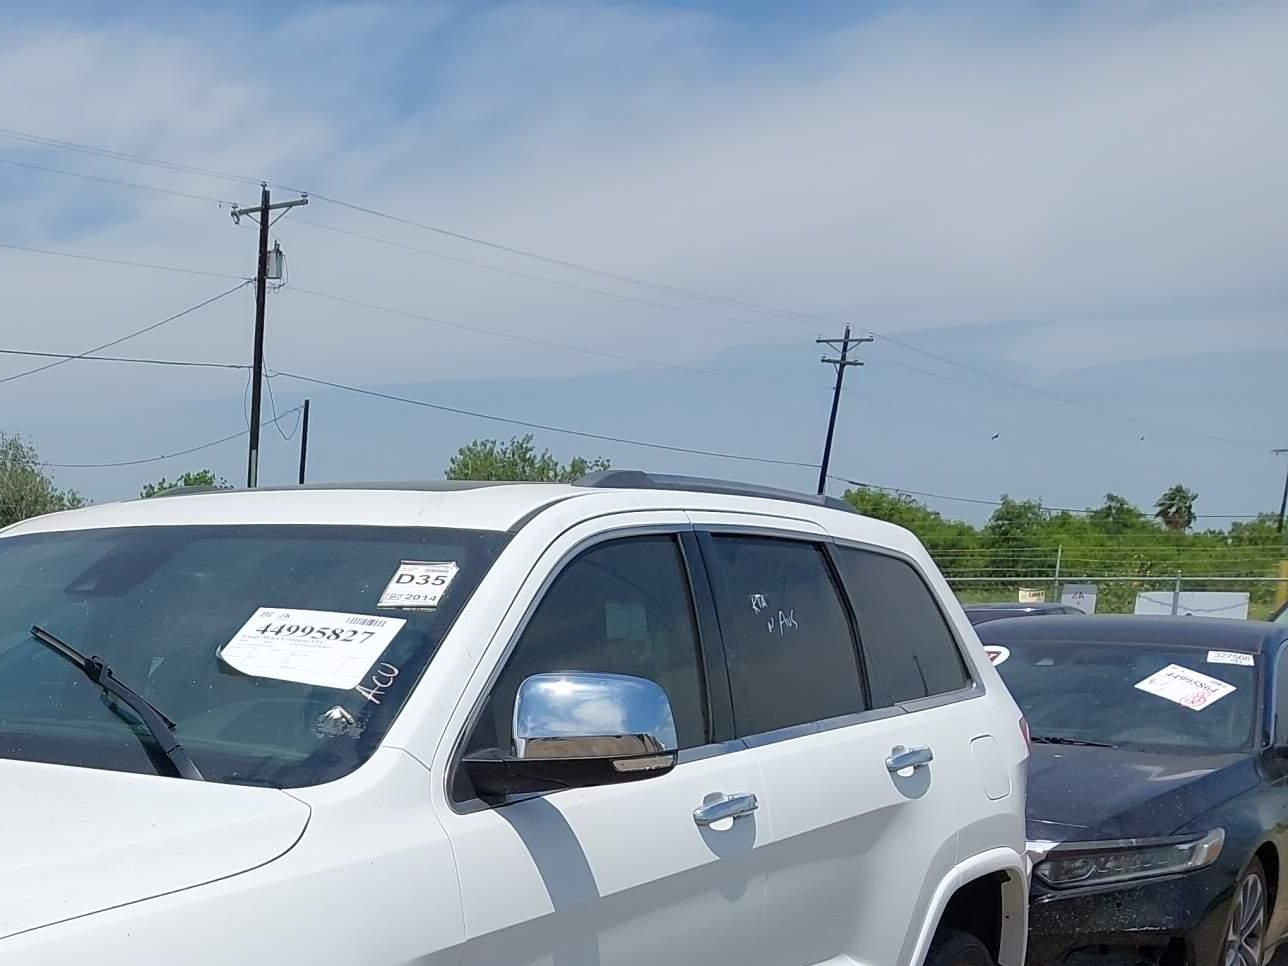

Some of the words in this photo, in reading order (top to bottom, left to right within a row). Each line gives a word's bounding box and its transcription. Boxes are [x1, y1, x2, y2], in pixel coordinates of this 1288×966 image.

[395, 573, 449, 586] D35
[403, 593, 437, 602] 2014
[255, 622, 376, 644] 44995827
